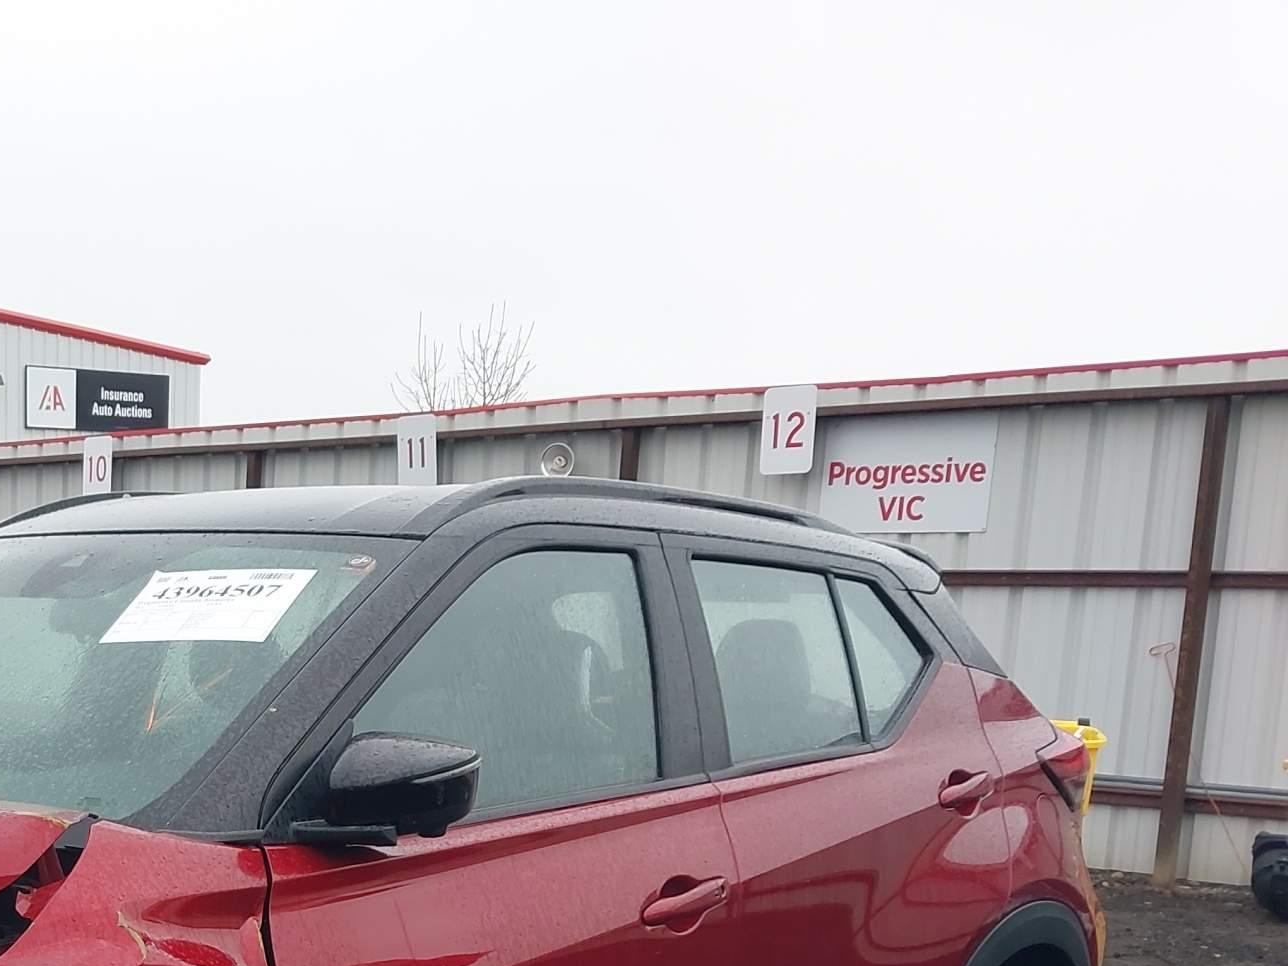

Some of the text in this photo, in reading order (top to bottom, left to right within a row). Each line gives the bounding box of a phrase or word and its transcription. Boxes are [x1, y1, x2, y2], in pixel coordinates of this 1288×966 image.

[100, 386, 144, 402] Insurance
[92, 402, 153, 419] Auto Auctions
[771, 411, 806, 449] 12
[407, 436, 425, 469] 11
[88, 455, 107, 483] 10
[827, 456, 987, 490] Progressive
[878, 495, 926, 522] VIC
[152, 583, 283, 600] 43964507
